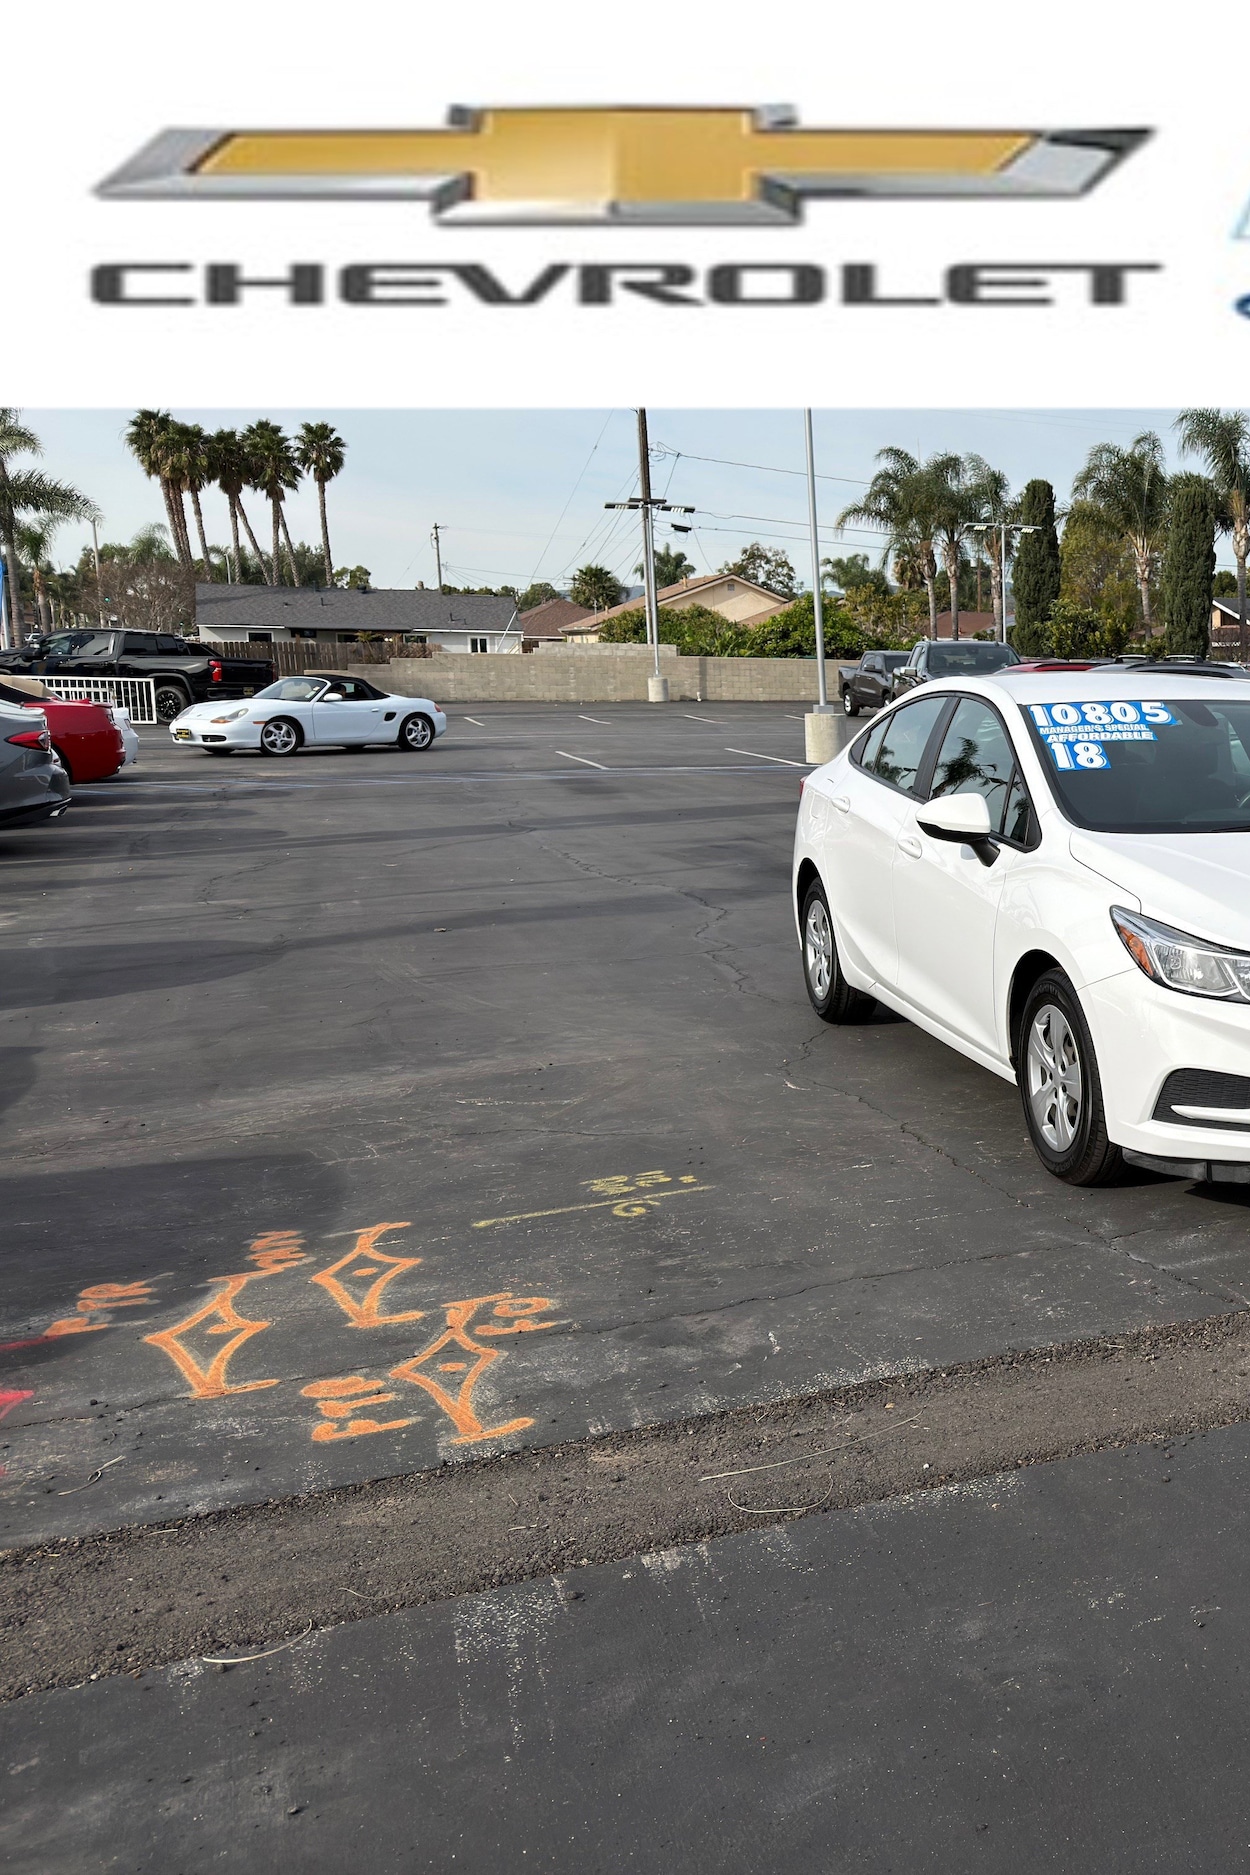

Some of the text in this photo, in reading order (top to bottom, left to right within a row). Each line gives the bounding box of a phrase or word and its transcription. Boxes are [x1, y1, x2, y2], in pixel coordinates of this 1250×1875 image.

[1030, 701, 1173, 727] 10805
[1046, 731, 1154, 743] AFFORDABLE
[1105, 724, 1149, 732] SPECIAL
[1051, 742, 1108, 770] 18
